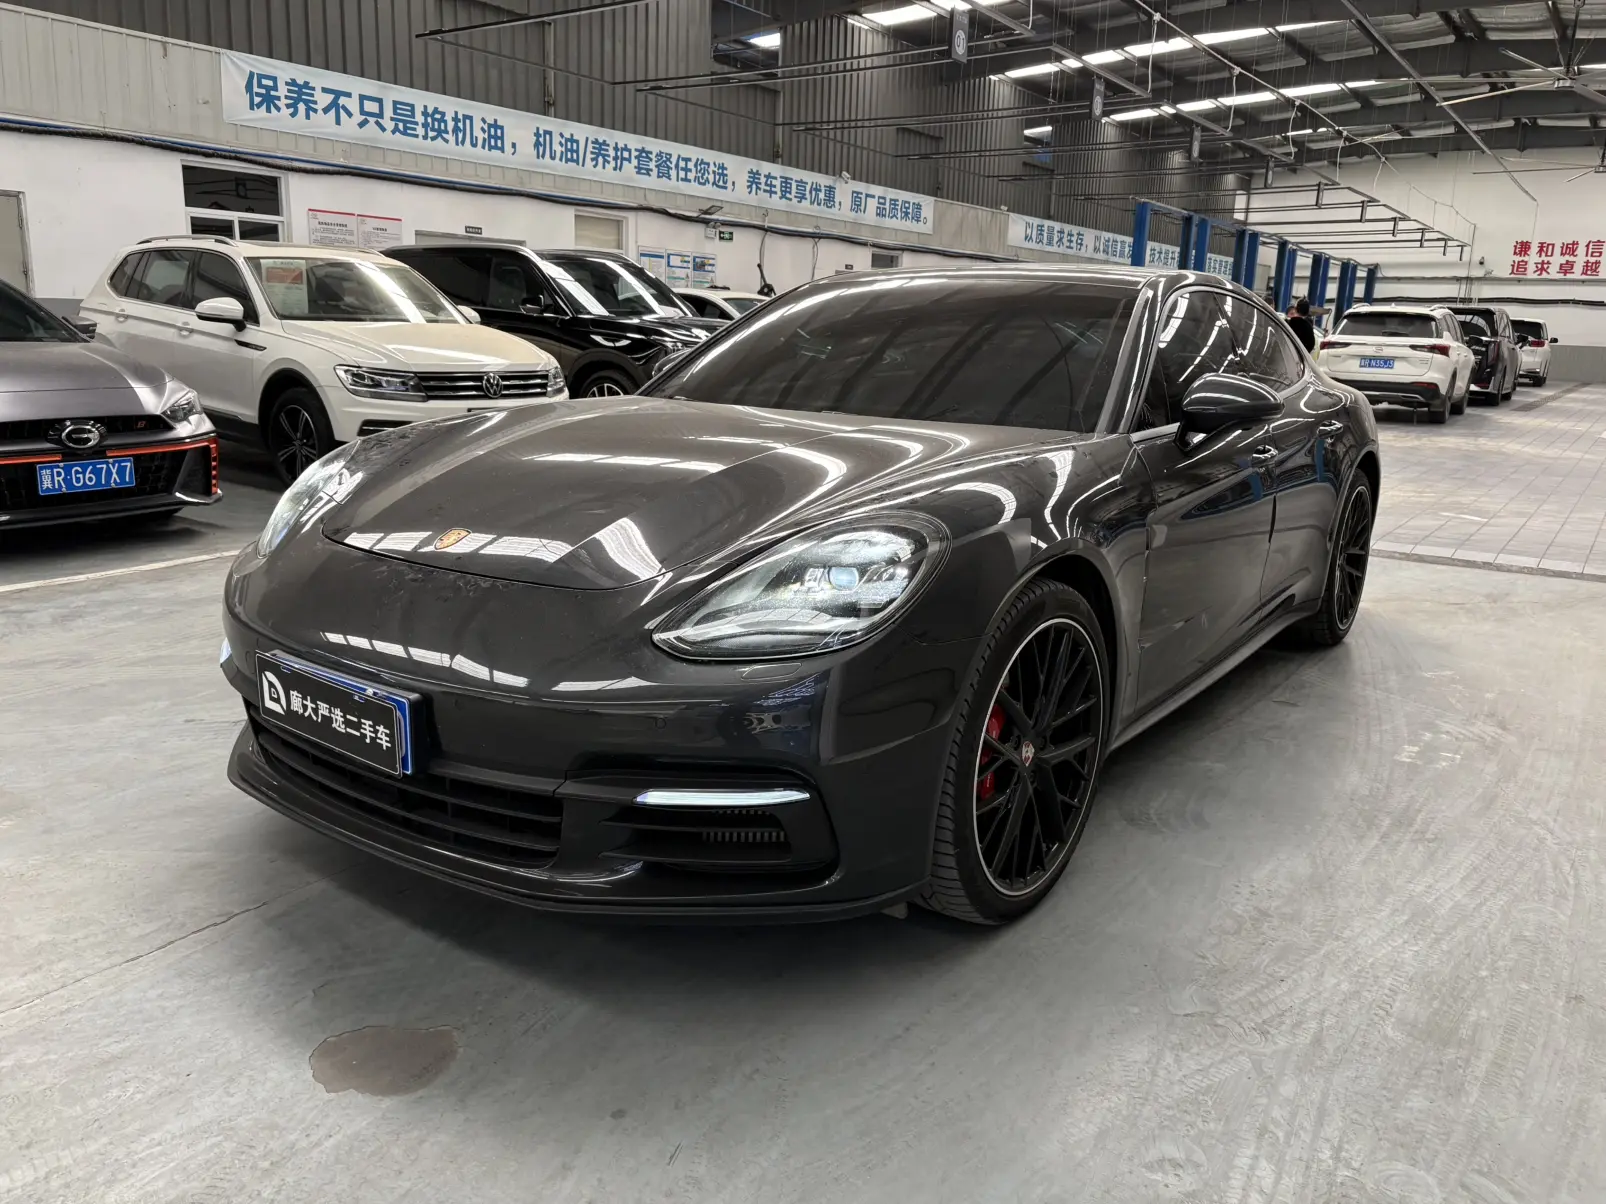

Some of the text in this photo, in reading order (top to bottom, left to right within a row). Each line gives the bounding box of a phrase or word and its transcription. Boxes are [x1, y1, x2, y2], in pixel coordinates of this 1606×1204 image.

[1512, 239, 1606, 258] 谦和诚信
[1509, 259, 1602, 277] 追求卓越
[290, 689, 392, 751] 廊大严选二手车
